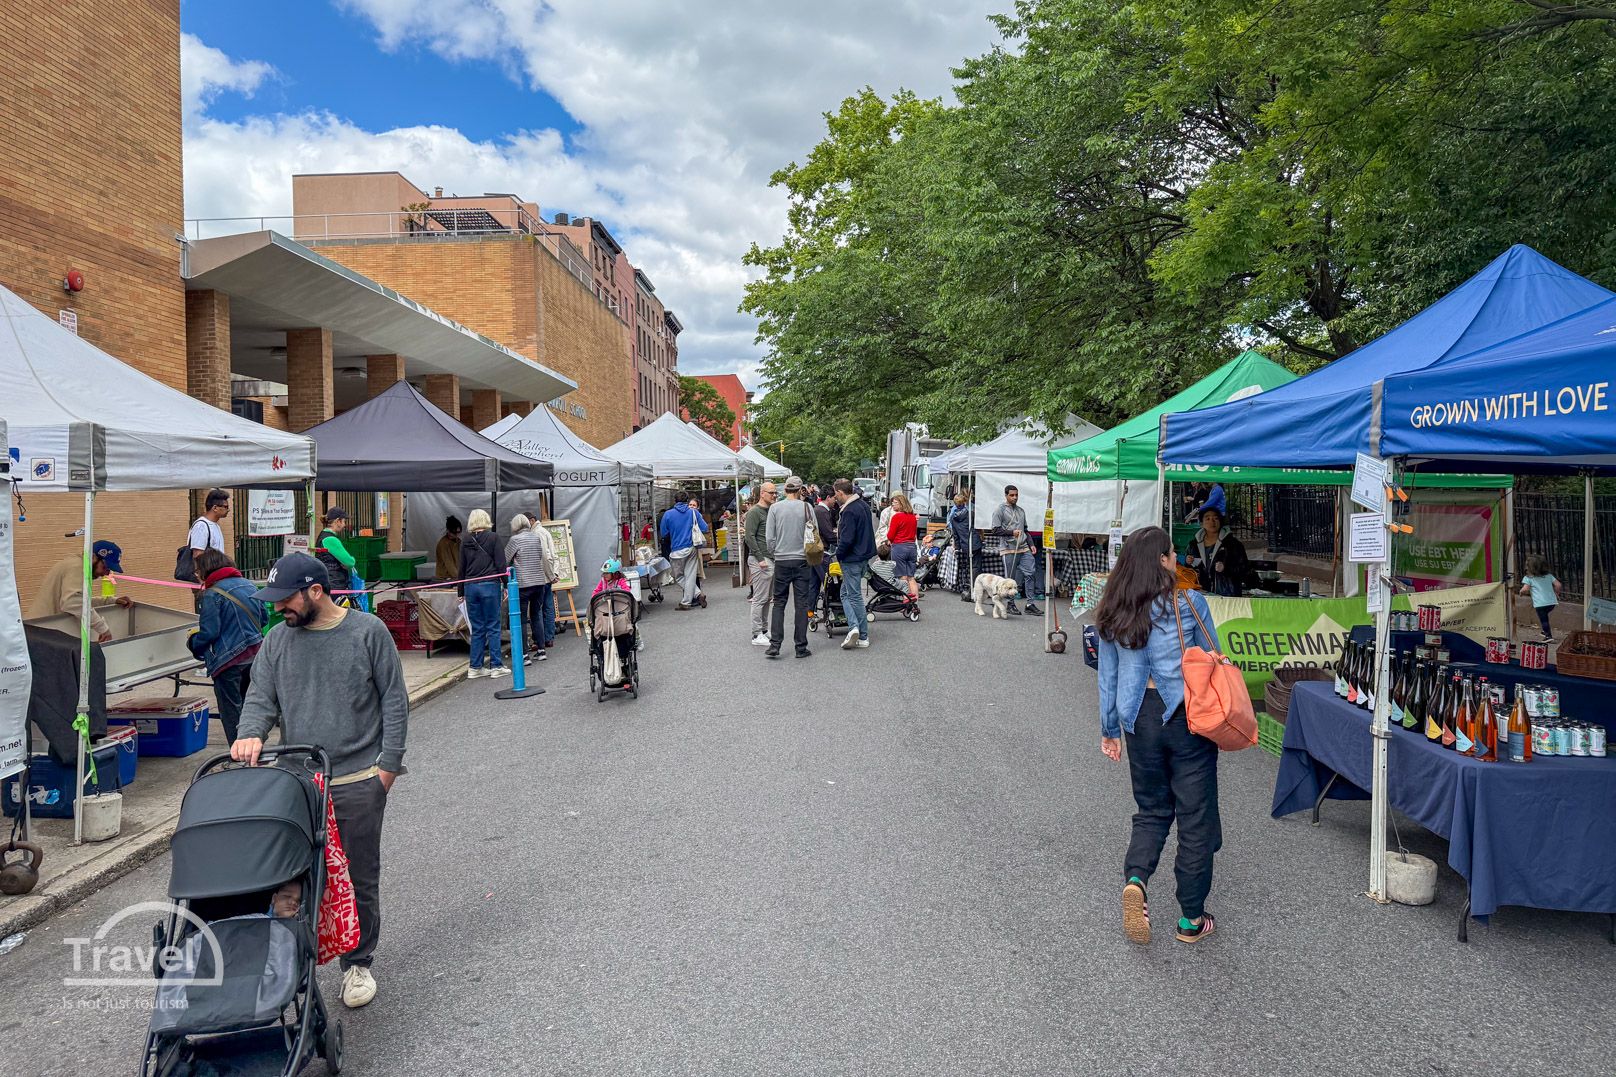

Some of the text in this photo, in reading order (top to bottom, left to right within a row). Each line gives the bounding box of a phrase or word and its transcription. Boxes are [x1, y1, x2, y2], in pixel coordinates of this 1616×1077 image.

[1410, 382, 1609, 428] GROWN WITH LOVE
[552, 471, 606, 482] YOGURT
[1409, 544, 1427, 557] USE
[1428, 547, 1448, 558] EBT
[1, 663, 27, 674] (frozen)
